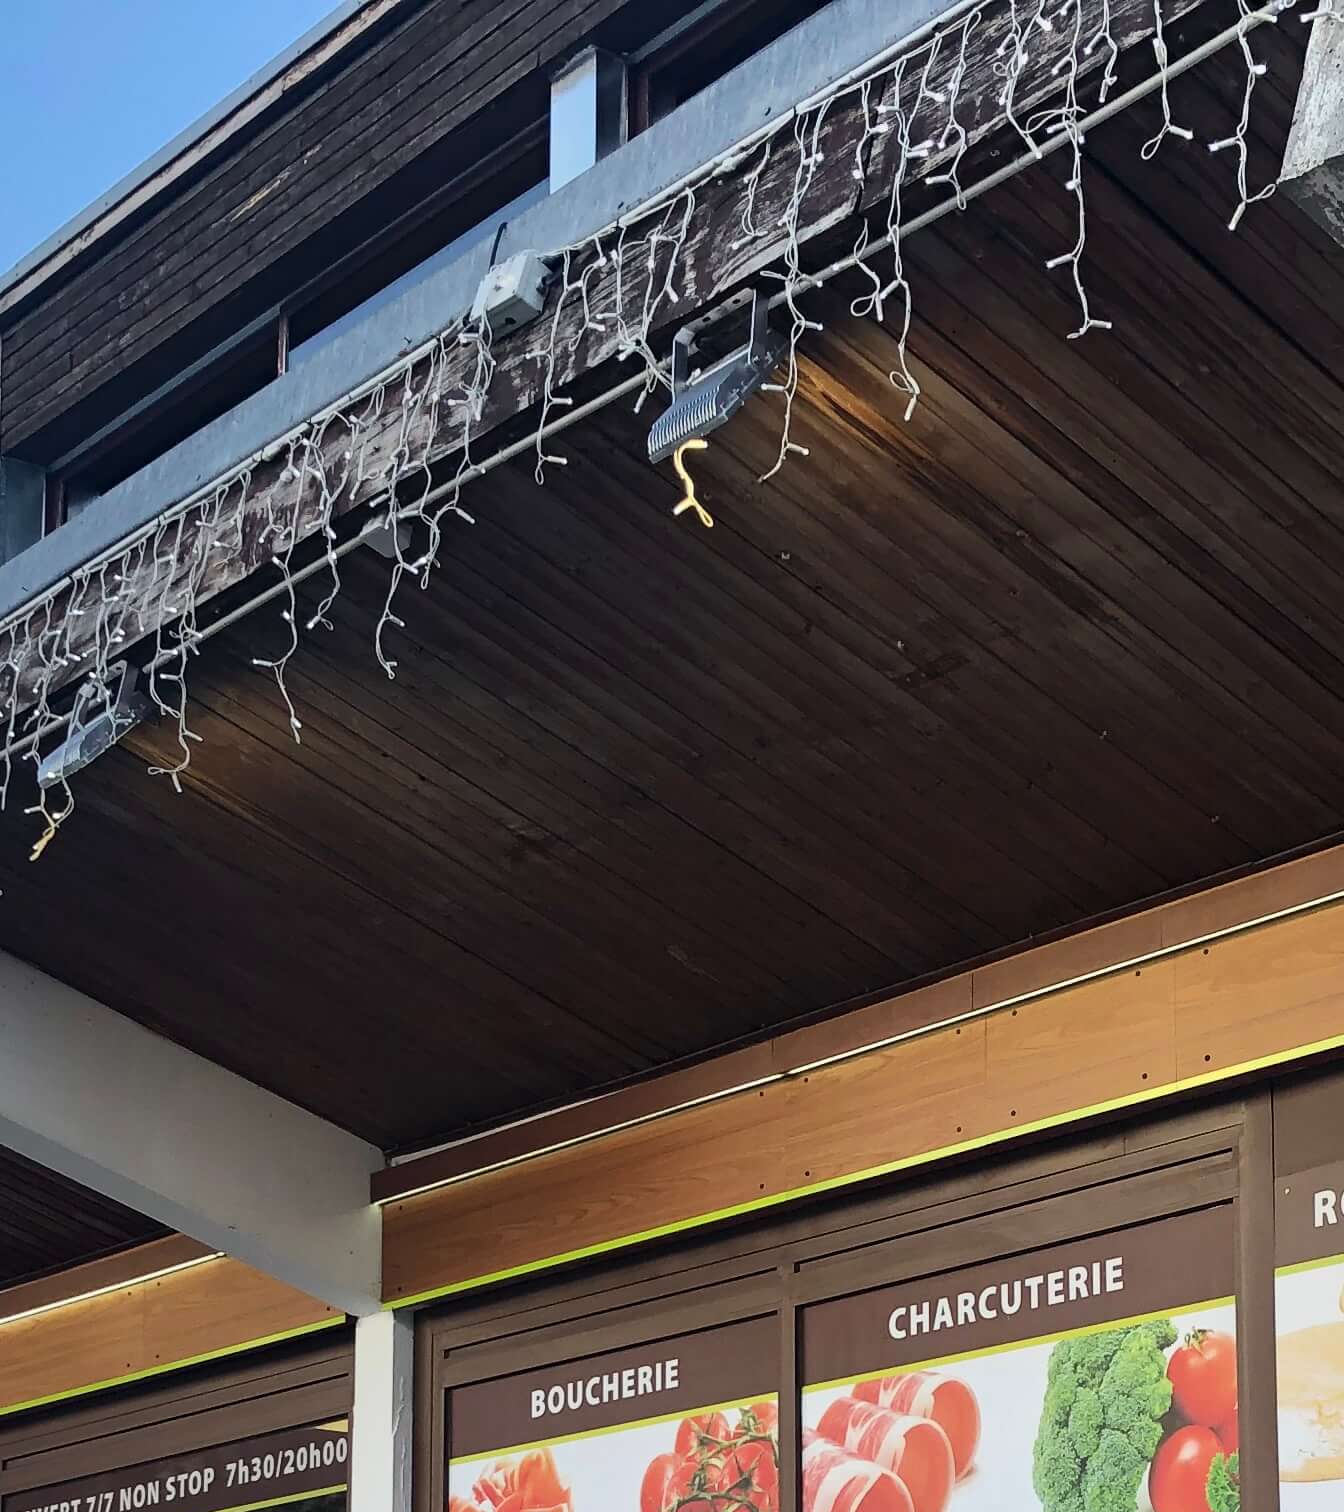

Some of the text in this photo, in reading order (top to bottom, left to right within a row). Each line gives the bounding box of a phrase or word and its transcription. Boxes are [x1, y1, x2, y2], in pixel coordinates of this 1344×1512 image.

[888, 1256, 1124, 1340] CHARCUTERIE
[531, 1359, 680, 1419] BOUCHERIE
[119, 1480, 159, 1512] NON
[166, 1467, 215, 1501] STOP
[226, 1437, 348, 1488] 7h30/20h00
